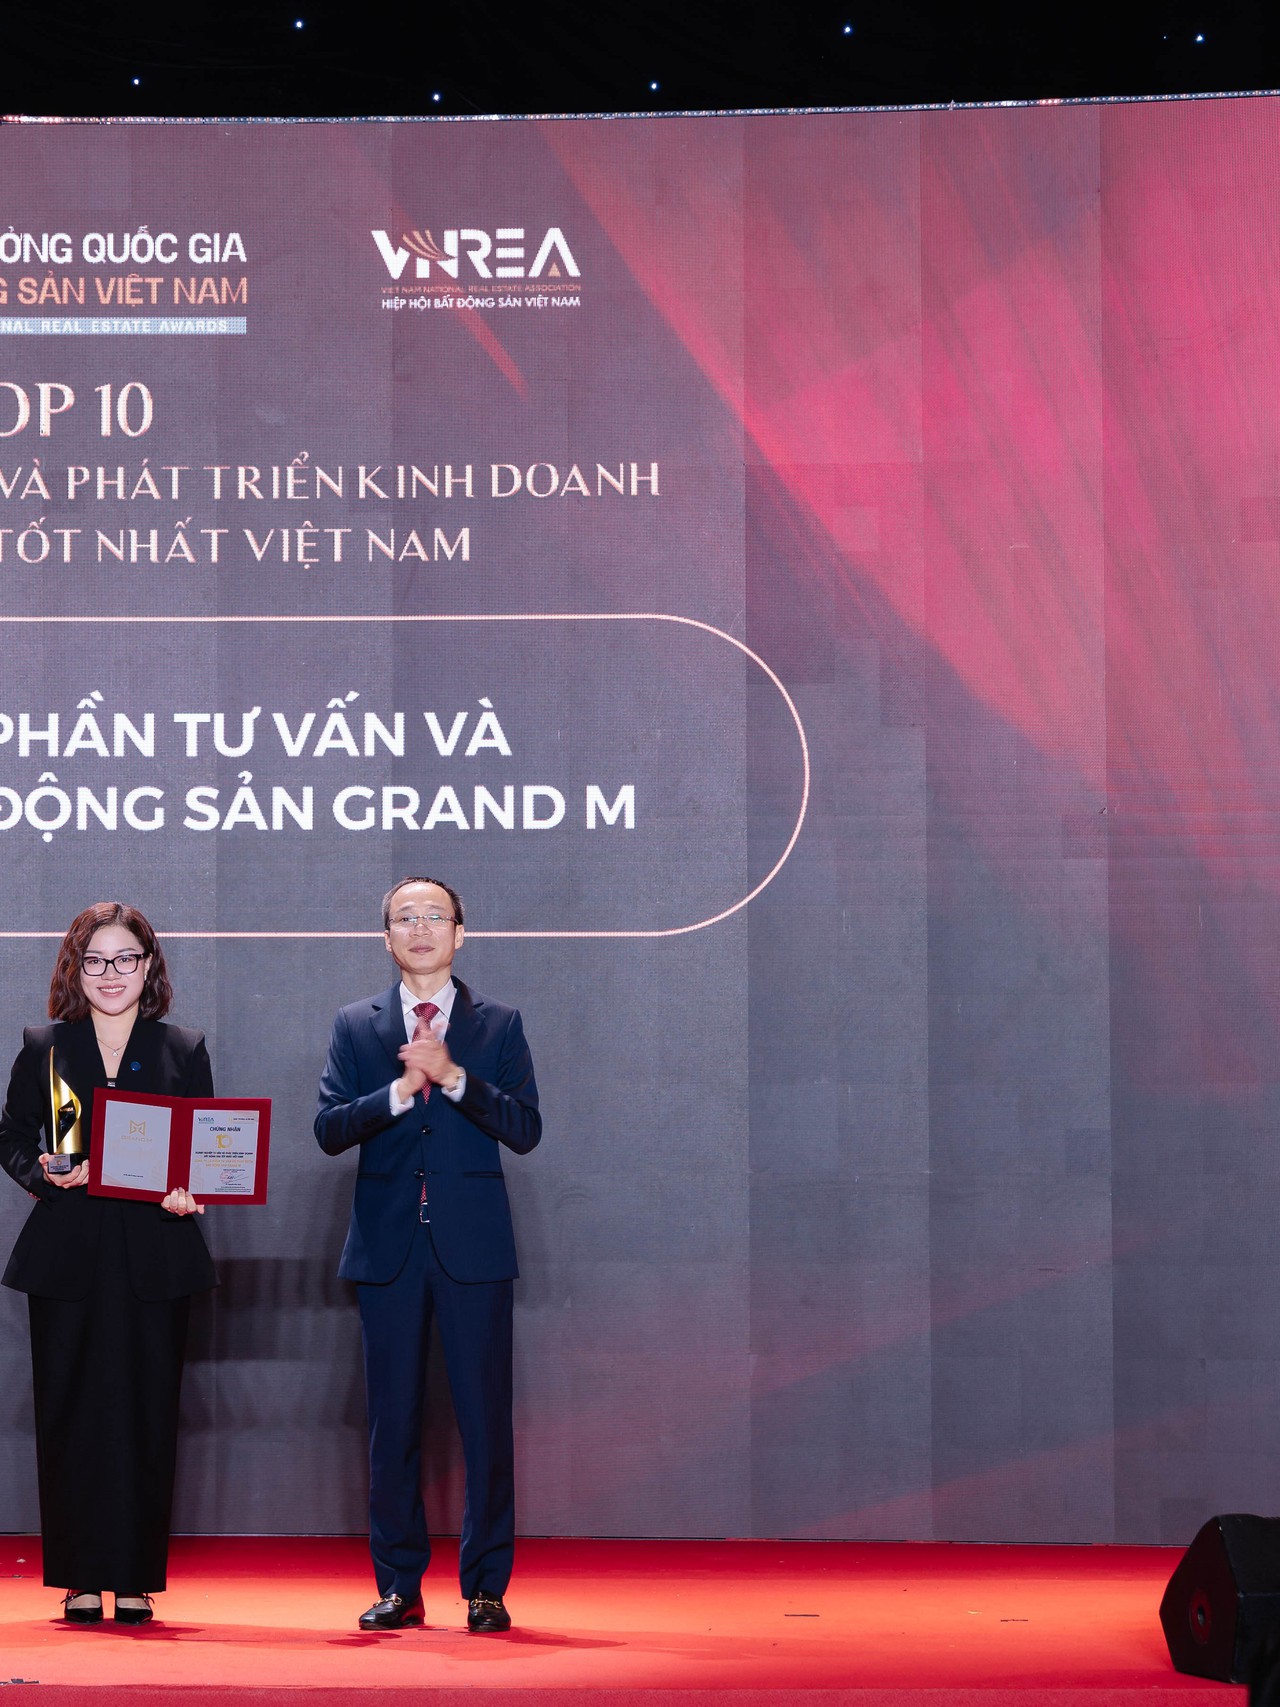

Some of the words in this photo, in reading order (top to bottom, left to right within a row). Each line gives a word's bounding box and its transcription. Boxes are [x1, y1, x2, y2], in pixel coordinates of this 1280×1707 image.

[82, 224, 178, 265] QUỐC
[188, 232, 248, 265] GIA
[370, 227, 582, 280] VNREA
[16, 270, 85, 305] SẢN
[94, 273, 164, 308] VIỆT
[173, 276, 248, 305] NAM
[382, 296, 407, 311] HIỆP
[409, 295, 432, 311] HỘI
[434, 294, 455, 309] BẤT
[456, 295, 496, 310] ĐỘNG
[498, 294, 522, 308] SẢN
[524, 294, 549, 309] VIỆT
[551, 296, 581, 308] NAM
[41, 320, 82, 333] REAL
[91, 320, 151, 333] ESTATE
[159, 320, 228, 333] AWARDS
[94, 381, 153, 438] 10
[67, 458, 190, 500] PHÁT
[203, 450, 343, 500] TRIỂN
[357, 464, 475, 499] KINH
[490, 462, 660, 498] DOANH
[94, 516, 229, 563] NHẤT
[242, 520, 352, 570] VIỆT
[366, 527, 470, 562] NAM
[173, 705, 262, 758] TƯ
[271, 690, 405, 757] VẤN
[423, 696, 513, 757] VÀ
[182, 770, 314, 831] SẢN
[332, 784, 566, 831] GRAND
[586, 784, 636, 830] M
